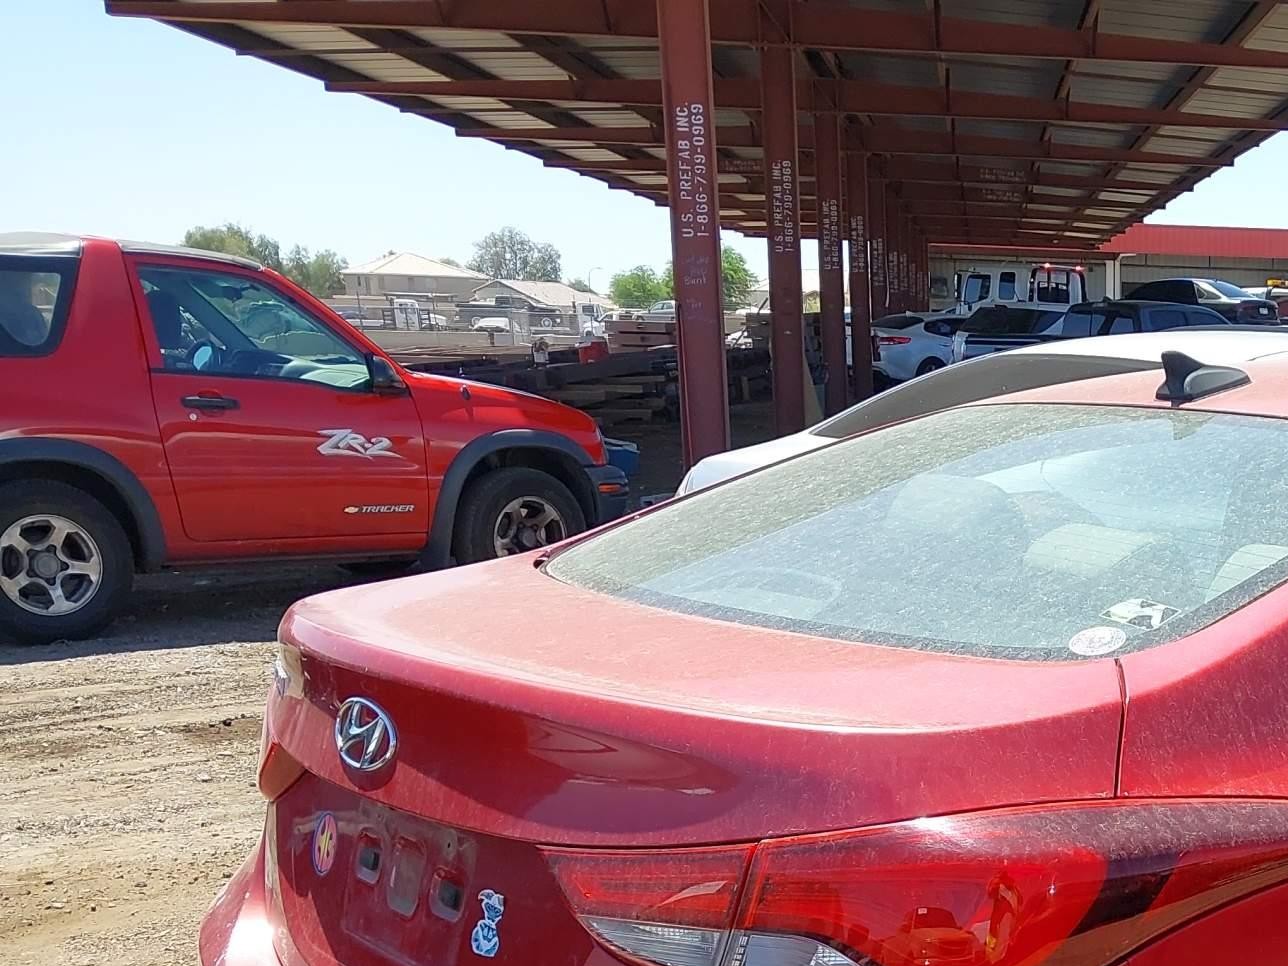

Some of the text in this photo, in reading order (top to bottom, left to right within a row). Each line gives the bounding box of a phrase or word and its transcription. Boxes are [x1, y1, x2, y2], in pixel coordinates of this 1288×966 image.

[676, 102, 694, 237] U.S. PREFAB INC.
[690, 104, 709, 236] 1-866-799-0969
[771, 159, 784, 252] U.S. PREFAB INC.
[782, 160, 793, 251] 1-866-799-0969
[361, 504, 415, 513] TRACKER
